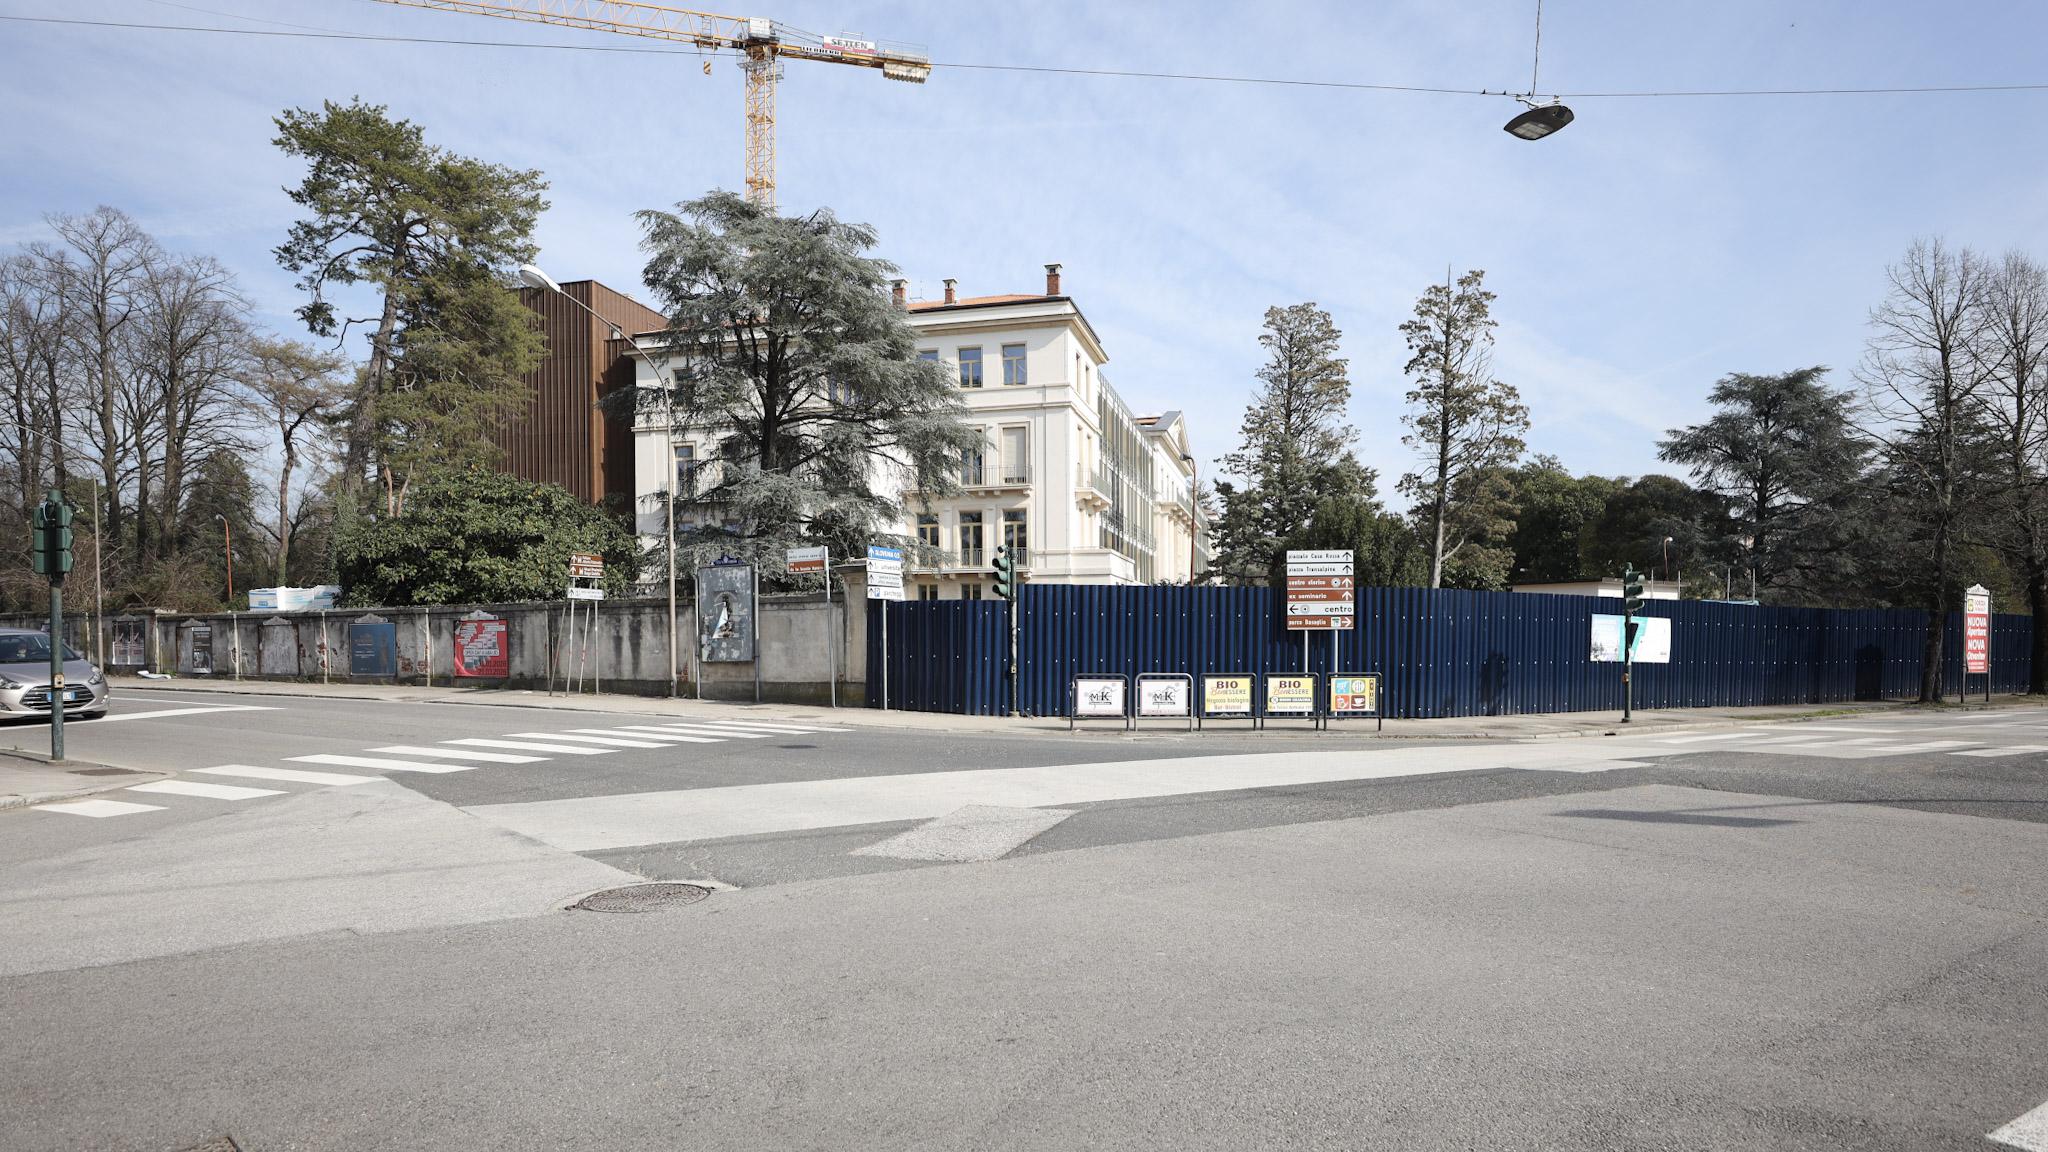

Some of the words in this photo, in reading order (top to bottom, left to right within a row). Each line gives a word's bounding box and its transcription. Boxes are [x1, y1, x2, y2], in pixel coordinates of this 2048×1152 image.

[831, 38, 868, 50] SETTEN
[1308, 578, 1326, 586] storico
[1304, 618, 1327, 626] Basaglia
[1968, 617, 1986, 627] NUOVA
[1968, 640, 1985, 650] NOVA
[1216, 680, 1239, 689] BIO
[1279, 680, 1302, 689] BIO
